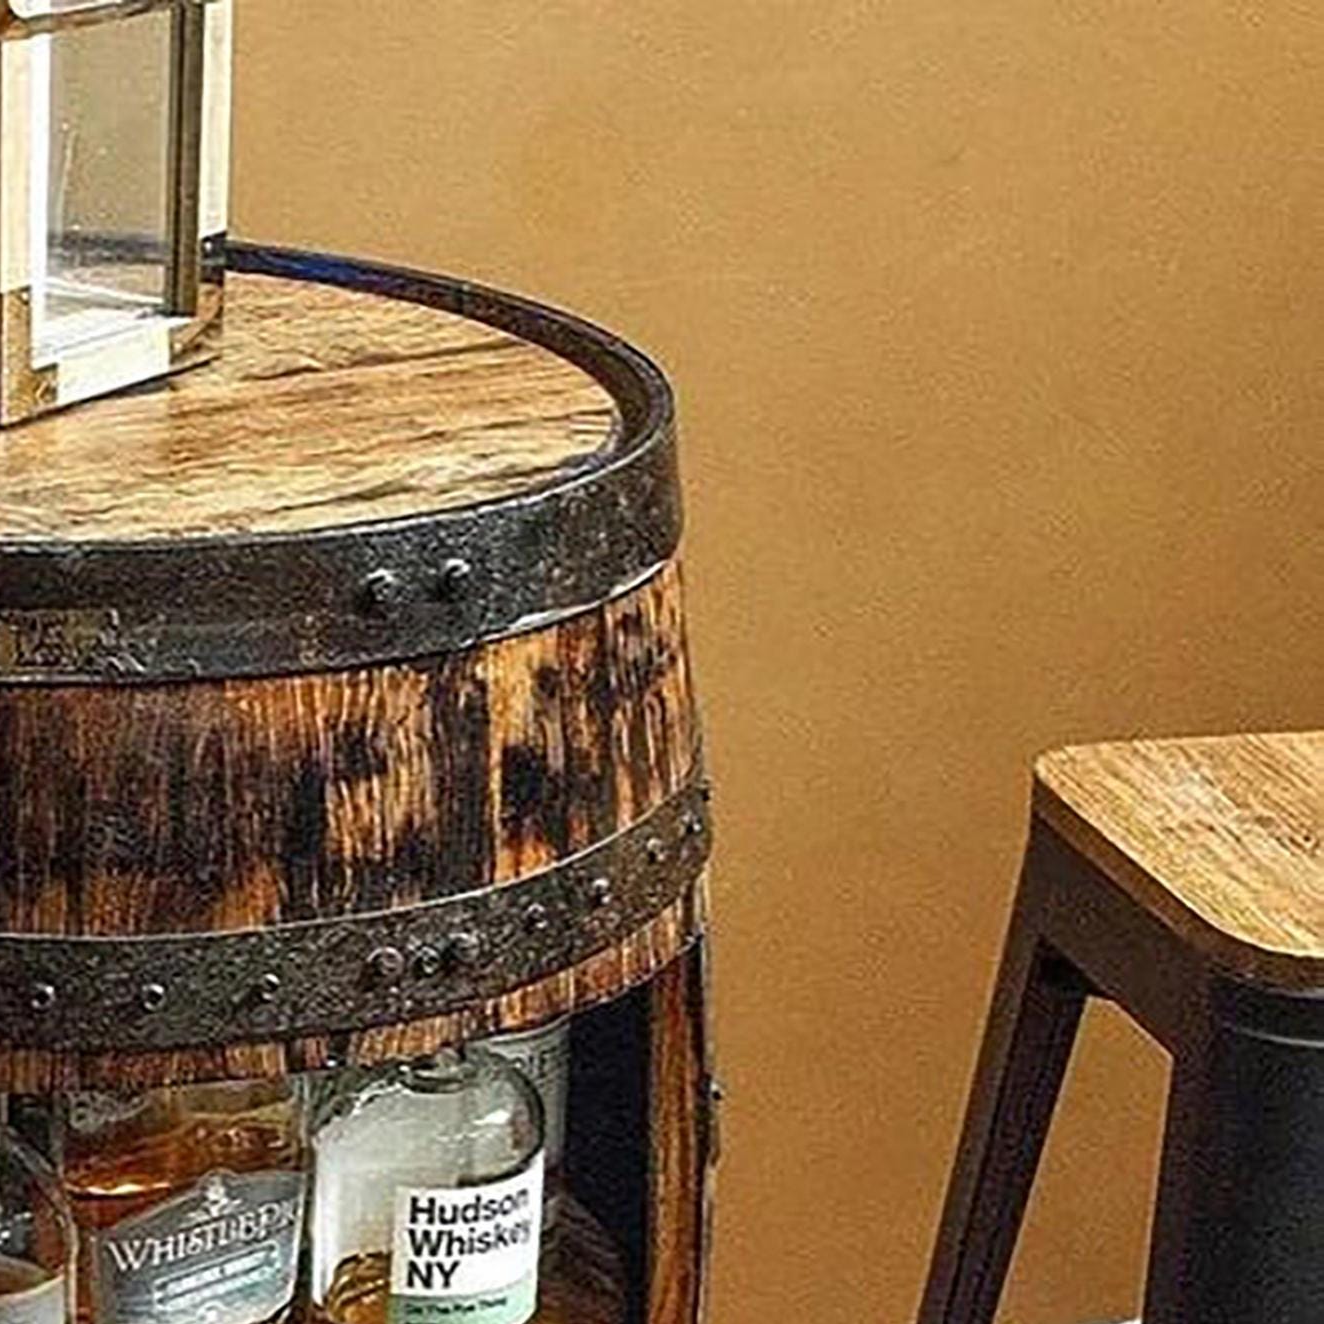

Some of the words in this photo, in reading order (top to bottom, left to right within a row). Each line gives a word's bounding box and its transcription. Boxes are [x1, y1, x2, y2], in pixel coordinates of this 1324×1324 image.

[409, 1188, 529, 1226] Hudson
[408, 1221, 532, 1258] Whiskey
[407, 1260, 460, 1289] NY
